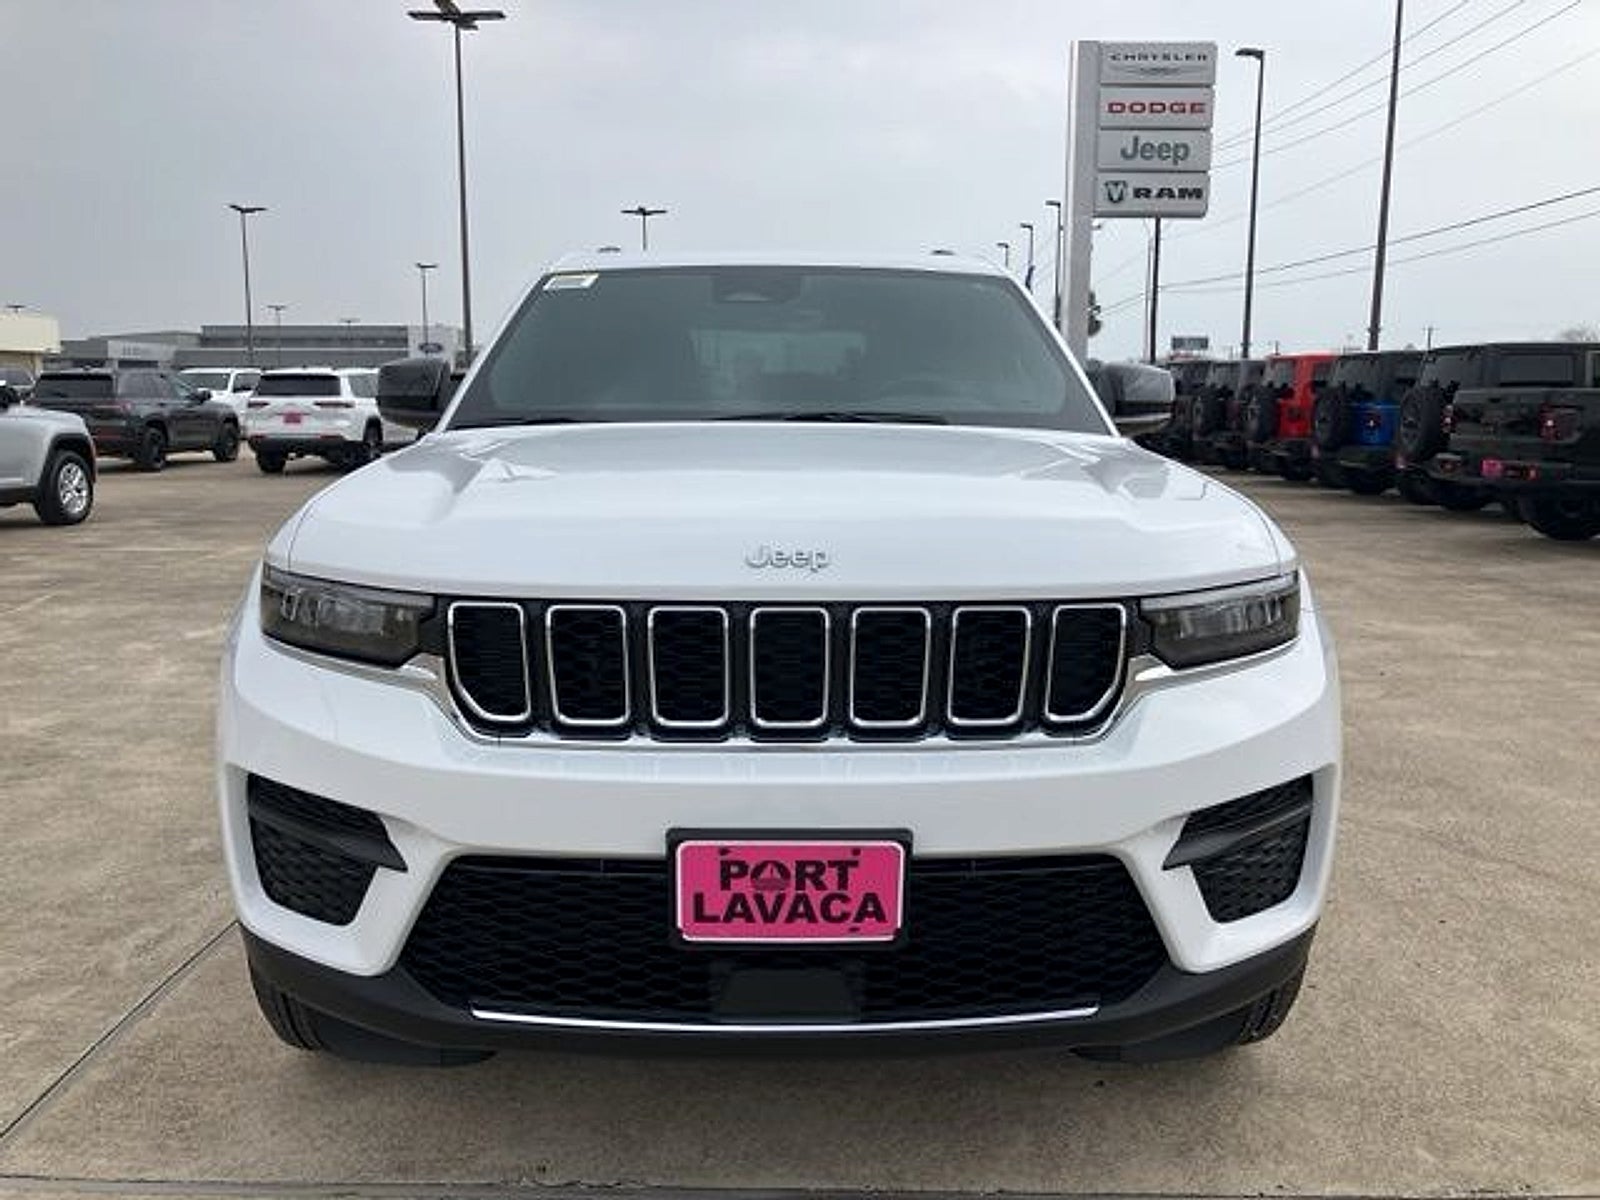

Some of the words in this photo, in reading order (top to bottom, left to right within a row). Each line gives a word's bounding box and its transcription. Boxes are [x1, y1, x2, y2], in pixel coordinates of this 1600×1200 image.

[1107, 102, 1206, 114] DODGE
[1120, 136, 1191, 166] Jeep
[1133, 187, 1204, 200] RAM
[744, 543, 831, 574] Jeep
[719, 859, 859, 892] PORT
[693, 891, 888, 924] LAVACA
